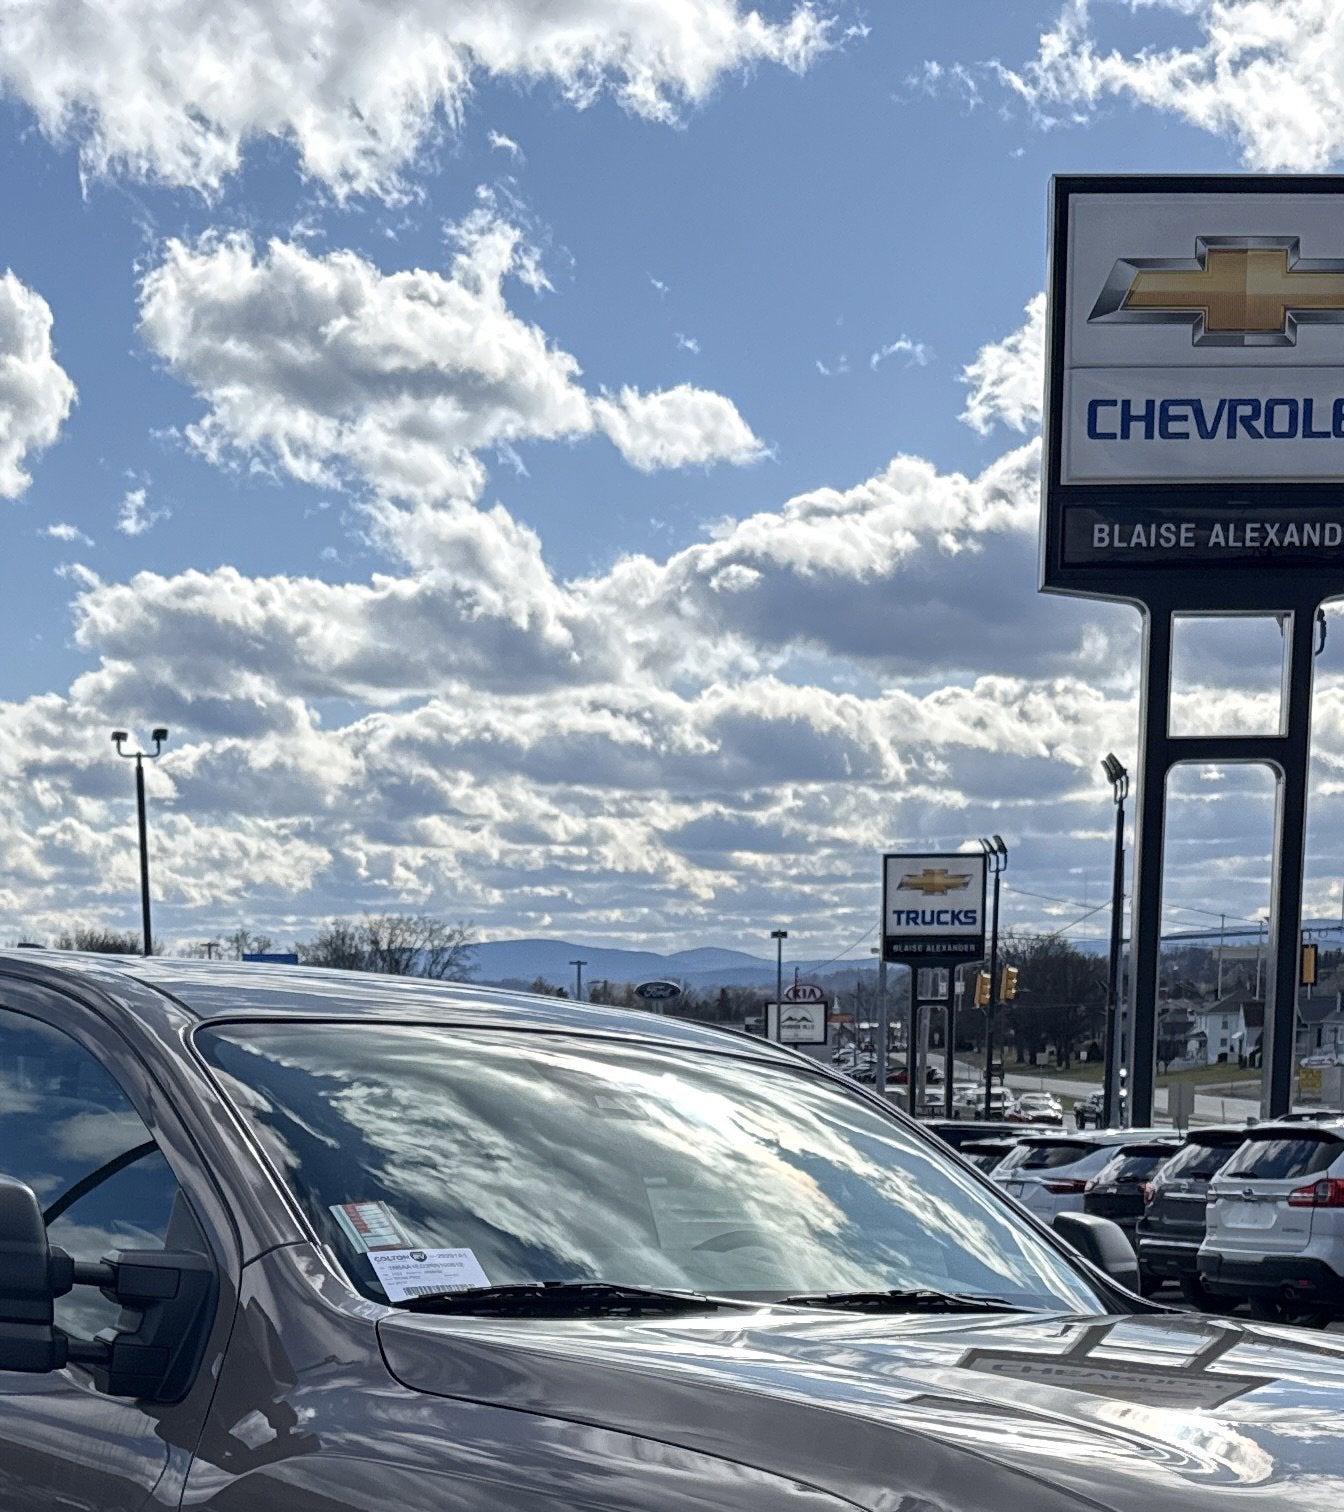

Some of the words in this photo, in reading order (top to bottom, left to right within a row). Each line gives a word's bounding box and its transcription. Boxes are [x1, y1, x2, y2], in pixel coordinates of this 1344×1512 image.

[1093, 523, 1196, 548] BLAISE
[892, 909, 977, 927] TRUCKS
[892, 943, 923, 953] BLAISE
[926, 943, 976, 953] ALEXANDER
[793, 988, 816, 1000] KIA
